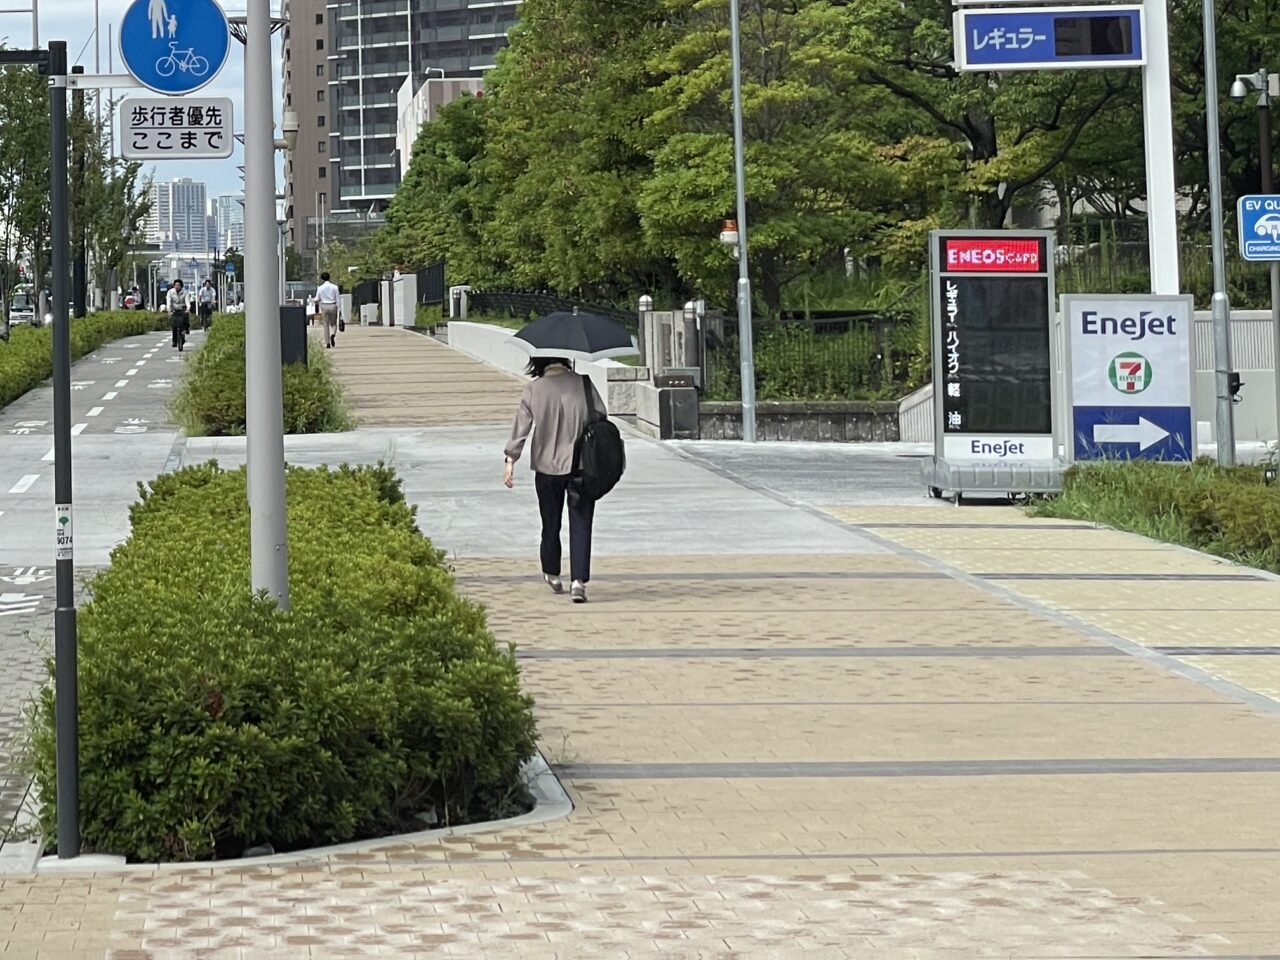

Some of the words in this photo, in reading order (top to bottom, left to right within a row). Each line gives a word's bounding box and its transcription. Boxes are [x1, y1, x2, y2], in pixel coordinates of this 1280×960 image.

[973, 27, 1046, 50] レギュラー
[131, 106, 223, 126] 歩行者優先
[132, 131, 223, 149] ここまで
[1246, 200, 1261, 210] EV
